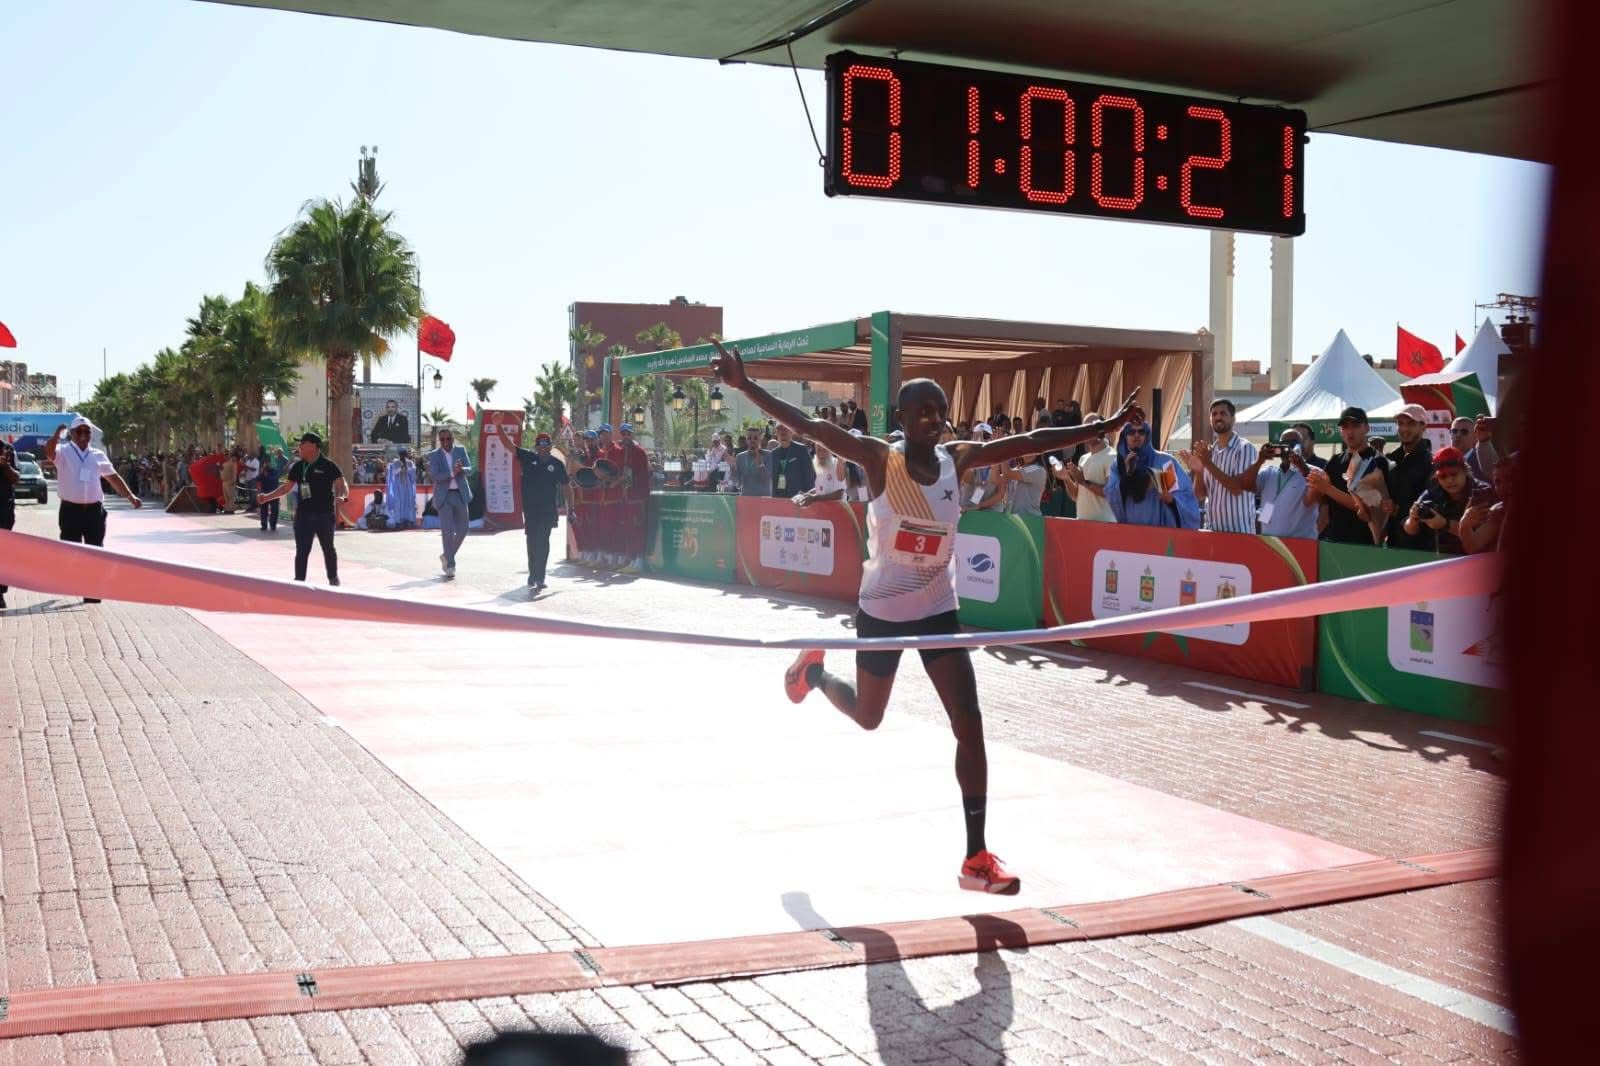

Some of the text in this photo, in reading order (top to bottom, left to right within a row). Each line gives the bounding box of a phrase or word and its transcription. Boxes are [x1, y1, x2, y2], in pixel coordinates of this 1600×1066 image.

[842, 64, 1294, 217] 01:00:21
[0, 423, 39, 433] sidi ali
[1370, 425, 1393, 433] TOCOLE
[914, 535, 926, 553] 3
